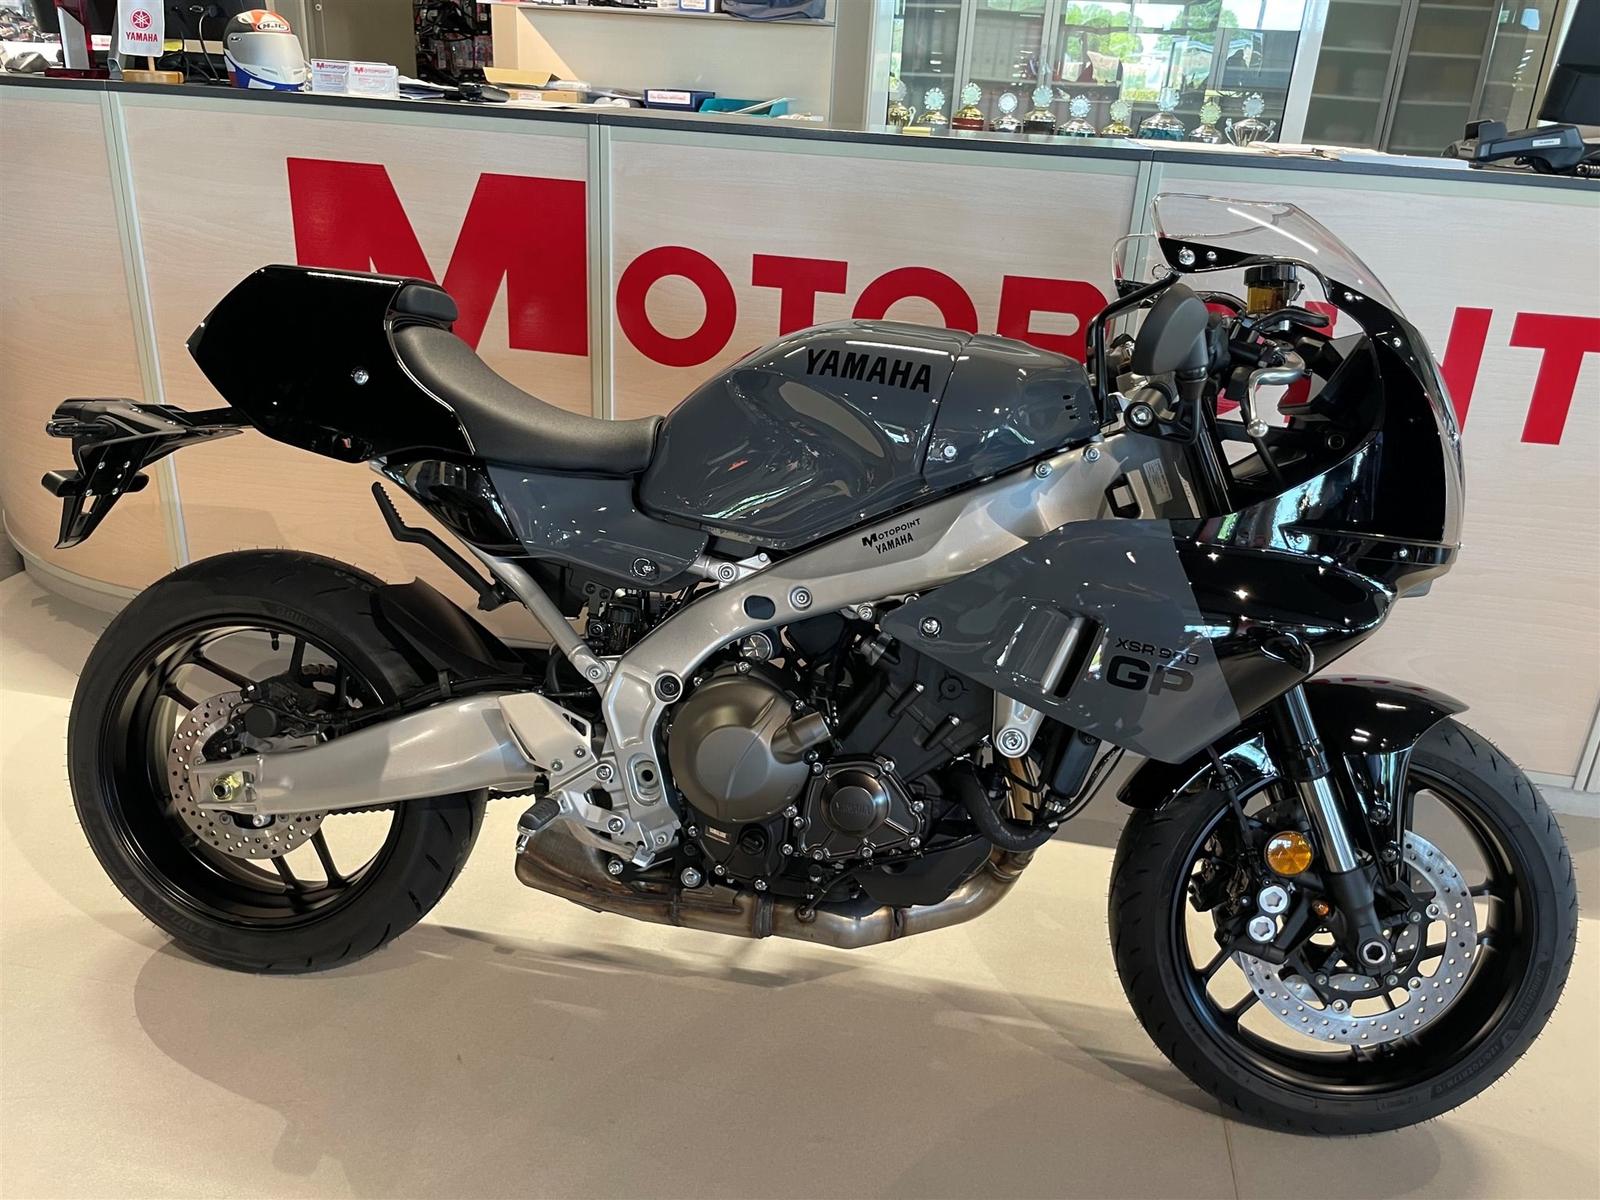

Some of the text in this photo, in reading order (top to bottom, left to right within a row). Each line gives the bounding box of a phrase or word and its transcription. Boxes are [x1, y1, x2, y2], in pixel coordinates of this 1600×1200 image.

[126, 31, 158, 42] YAMAHA
[286, 157, 1600, 445] MOTOPT
[806, 349, 931, 393] YAMAHA
[861, 518, 920, 547] MOTOPOINT
[875, 533, 914, 554] YAMAHA
[1115, 638, 1156, 656] XSR
[1106, 655, 1194, 696] GP
